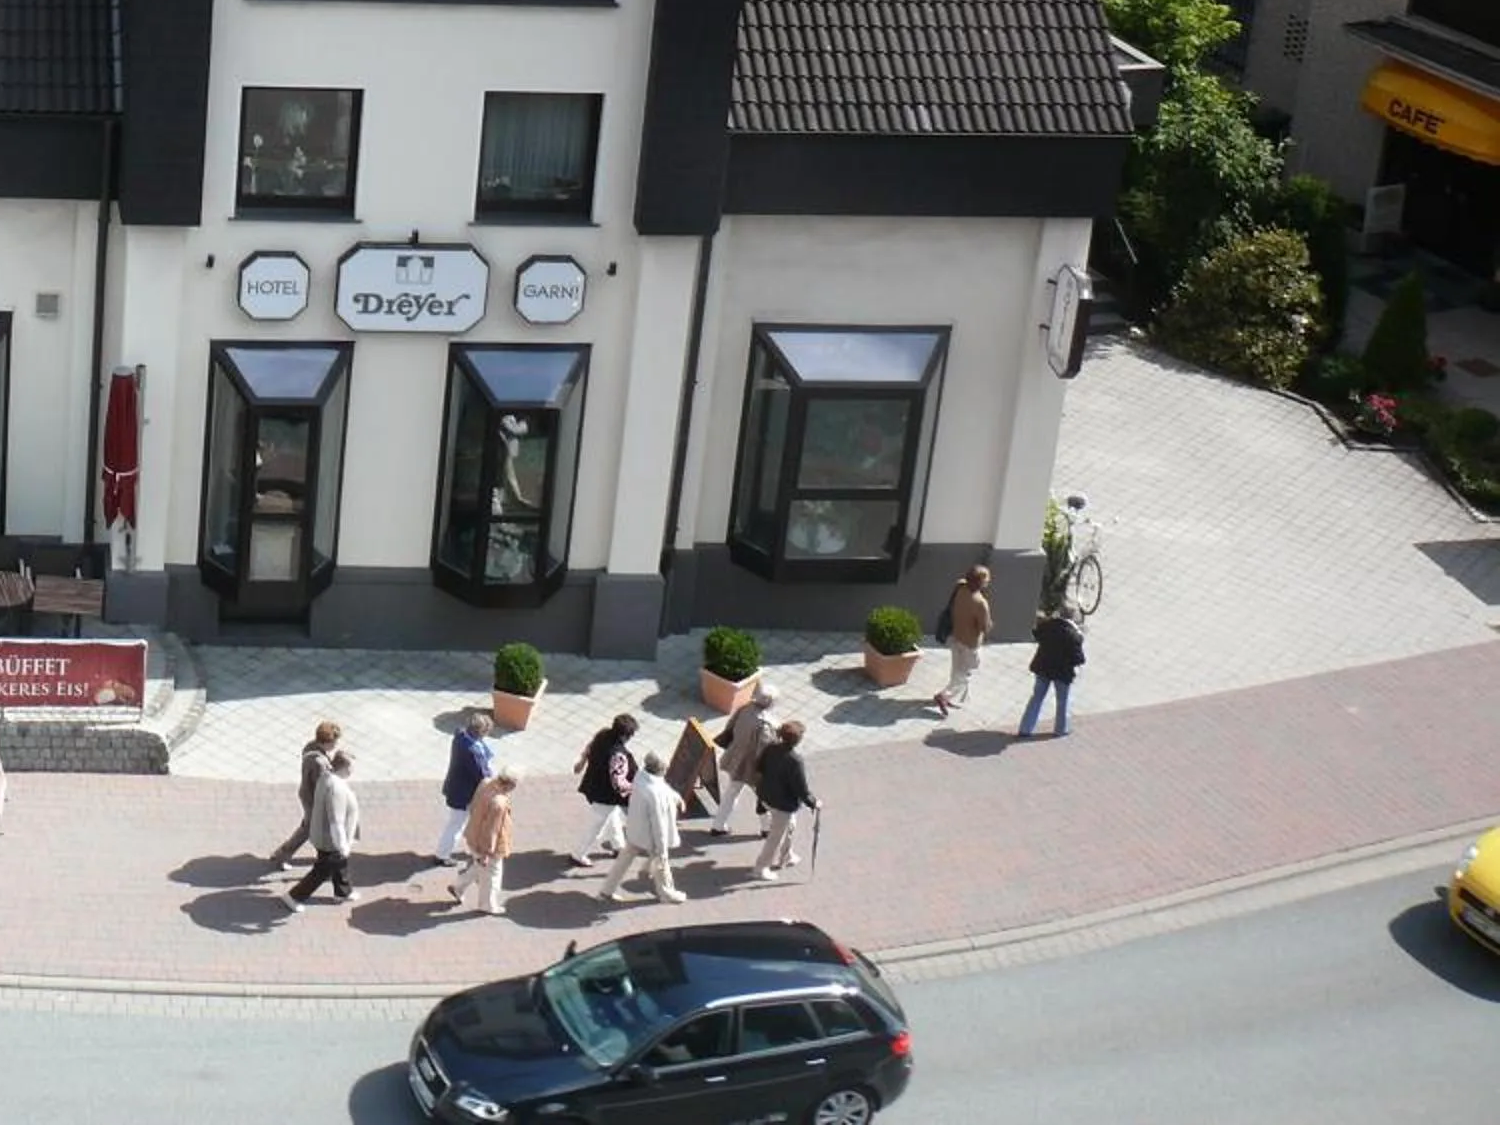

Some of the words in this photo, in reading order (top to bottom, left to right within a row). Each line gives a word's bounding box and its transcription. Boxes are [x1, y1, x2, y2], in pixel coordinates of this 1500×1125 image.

[246, 280, 300, 295] HOTEL
[352, 292, 471, 322] Dreyer
[56, 680, 90, 697] EIS!
